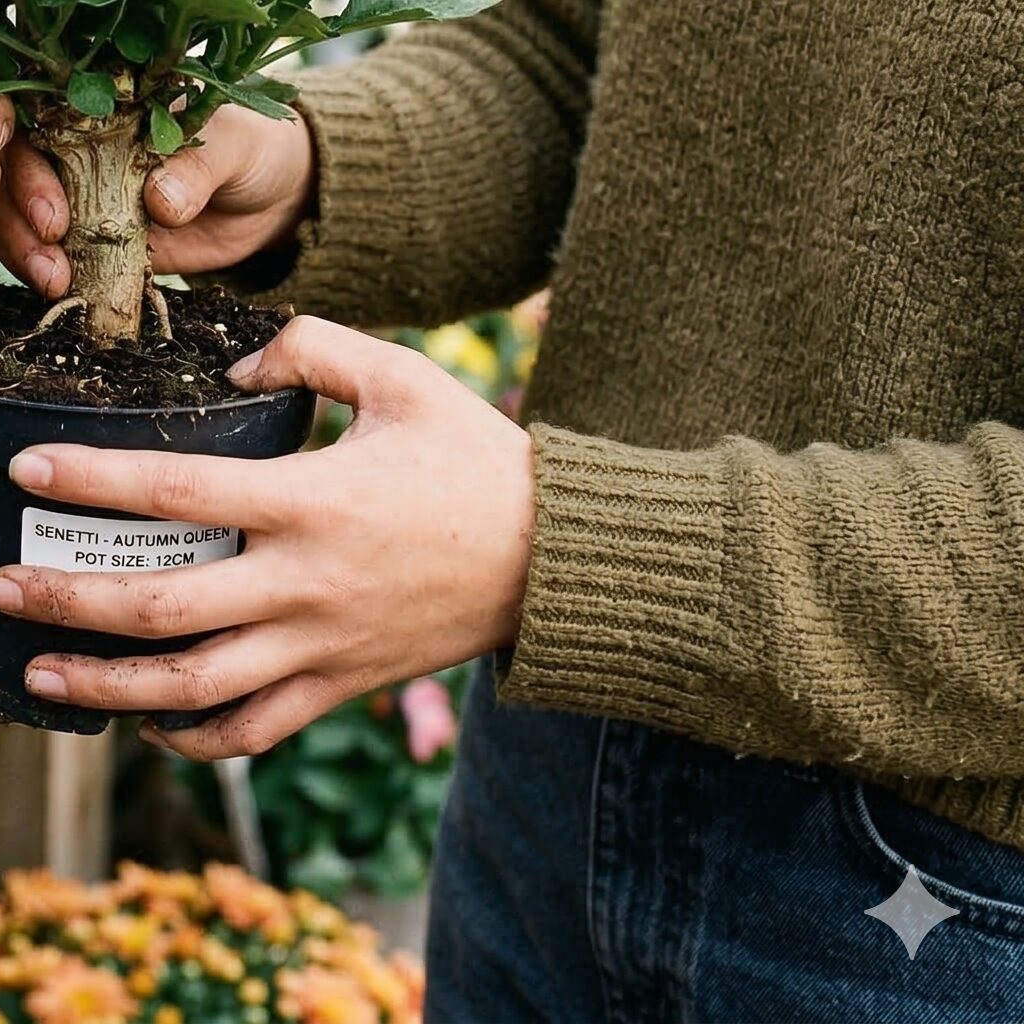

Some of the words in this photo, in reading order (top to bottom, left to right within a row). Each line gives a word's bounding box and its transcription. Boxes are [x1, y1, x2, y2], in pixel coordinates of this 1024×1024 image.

[35, 524, 99, 545] SENETTI
[113, 534, 179, 547] AUTUMN
[184, 527, 230, 544] QUEEN
[75, 552, 107, 566] POT
[111, 555, 150, 567] SIZE:
[156, 552, 194, 566] 12CM
